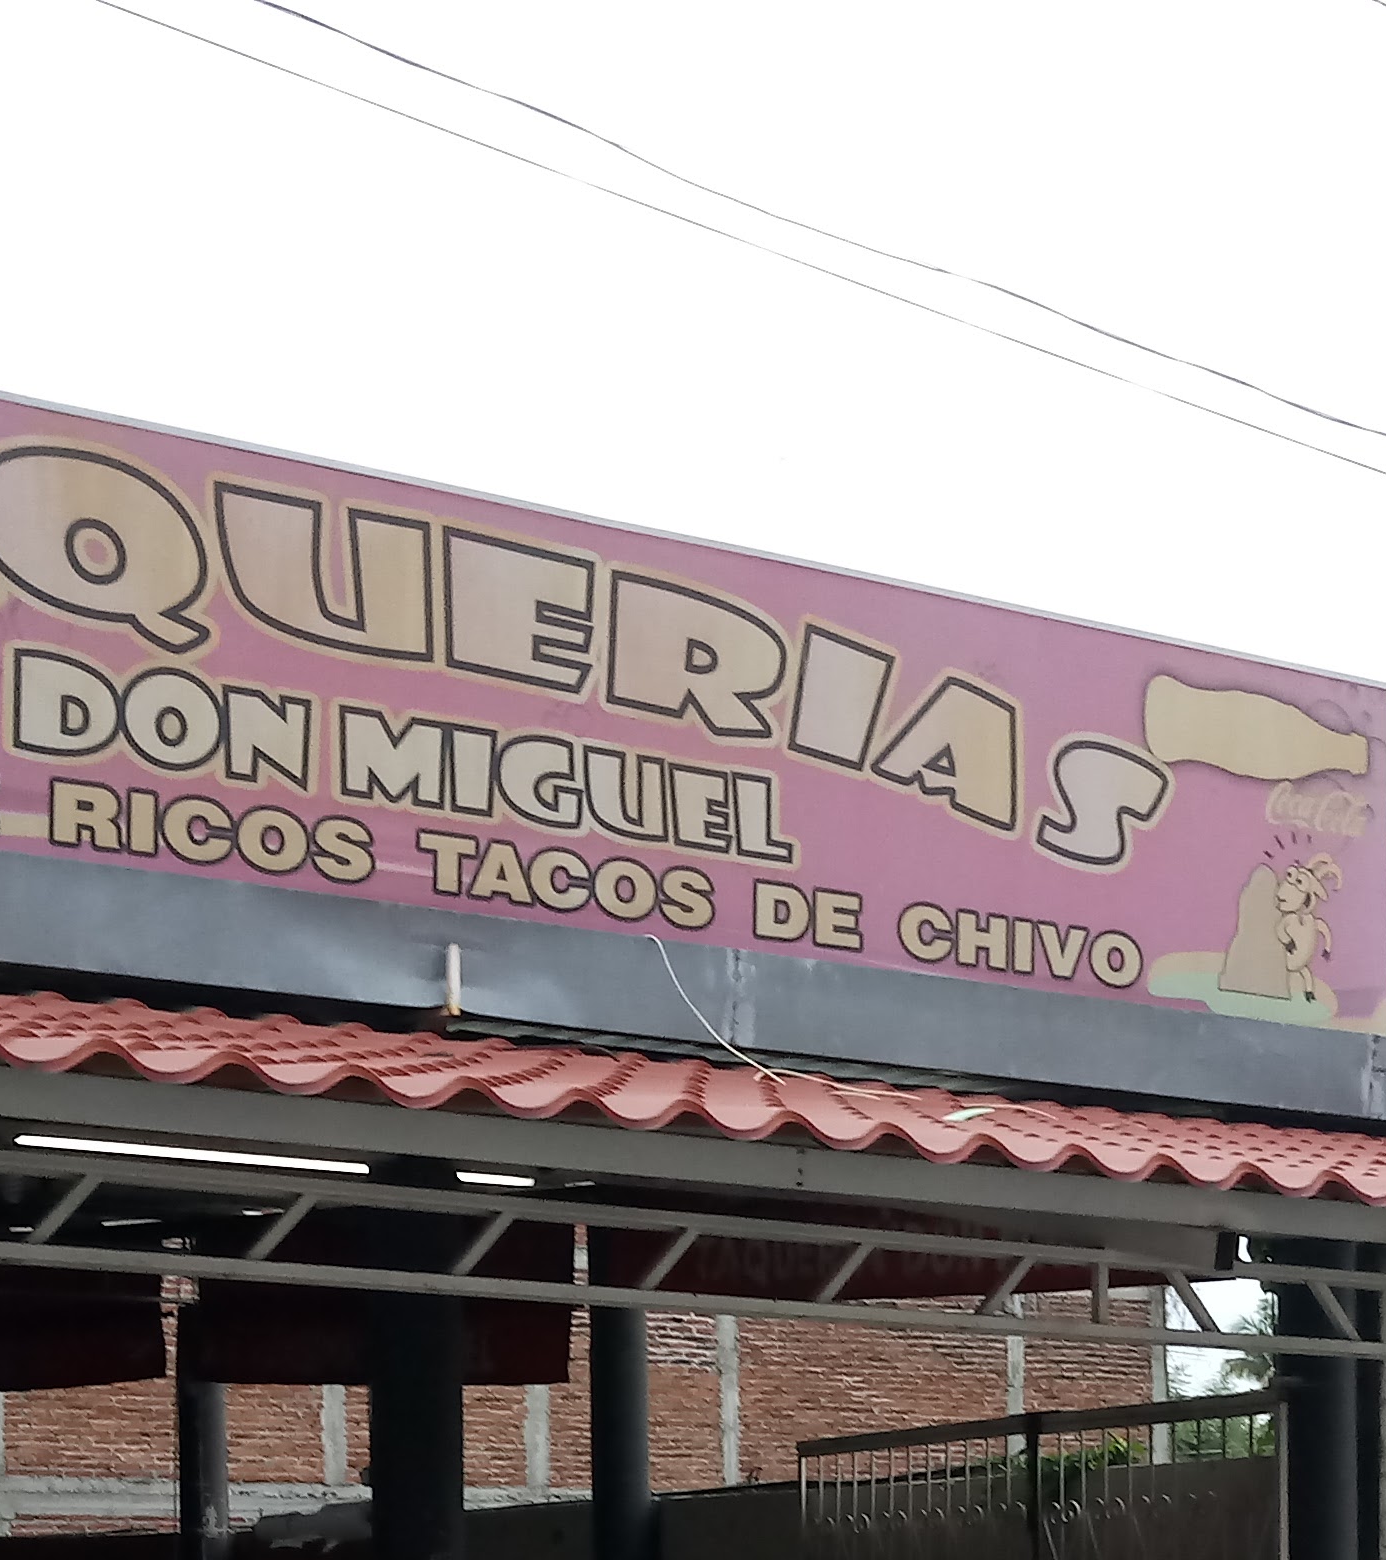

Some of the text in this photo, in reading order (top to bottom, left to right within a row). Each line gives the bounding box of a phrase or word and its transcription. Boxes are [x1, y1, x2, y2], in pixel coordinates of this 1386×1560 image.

[14, 648, 796, 863] DON MIGUEL
[49, 779, 376, 885] RICOS
[419, 833, 716, 931] TACOS
[753, 880, 863, 951] DE
[897, 900, 1145, 990] CHIVO
